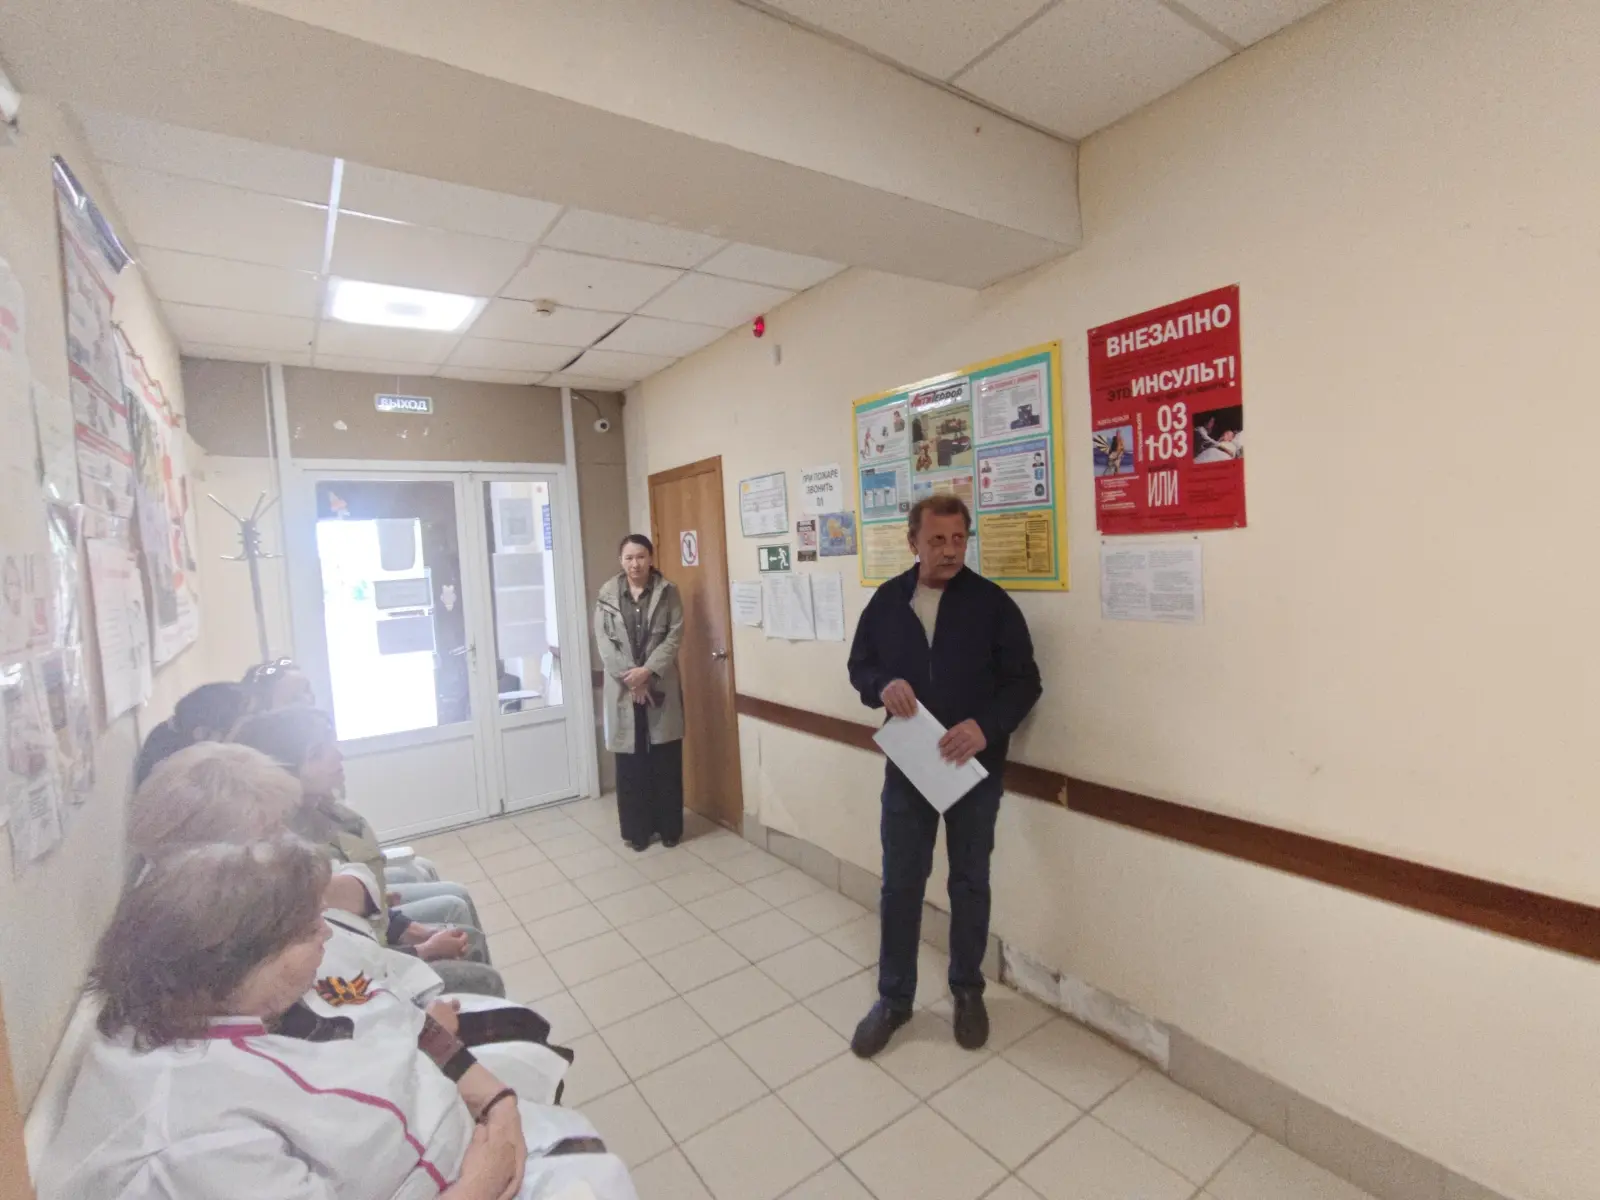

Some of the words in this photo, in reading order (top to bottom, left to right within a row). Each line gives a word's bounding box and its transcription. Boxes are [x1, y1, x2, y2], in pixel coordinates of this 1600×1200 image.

[1106, 303, 1232, 358] ВНЕЗАПНО
[1131, 355, 1236, 397] ИНСУЛЬТ!
[380, 398, 428, 411] ВЫХОД
[1157, 402, 1187, 432] 03
[802, 474, 813, 484] ПРИ
[813, 468, 839, 481] ПОЖАРЕ
[806, 482, 834, 495] ЗВОНИТЬ
[1147, 470, 1178, 507] ИЛИ
